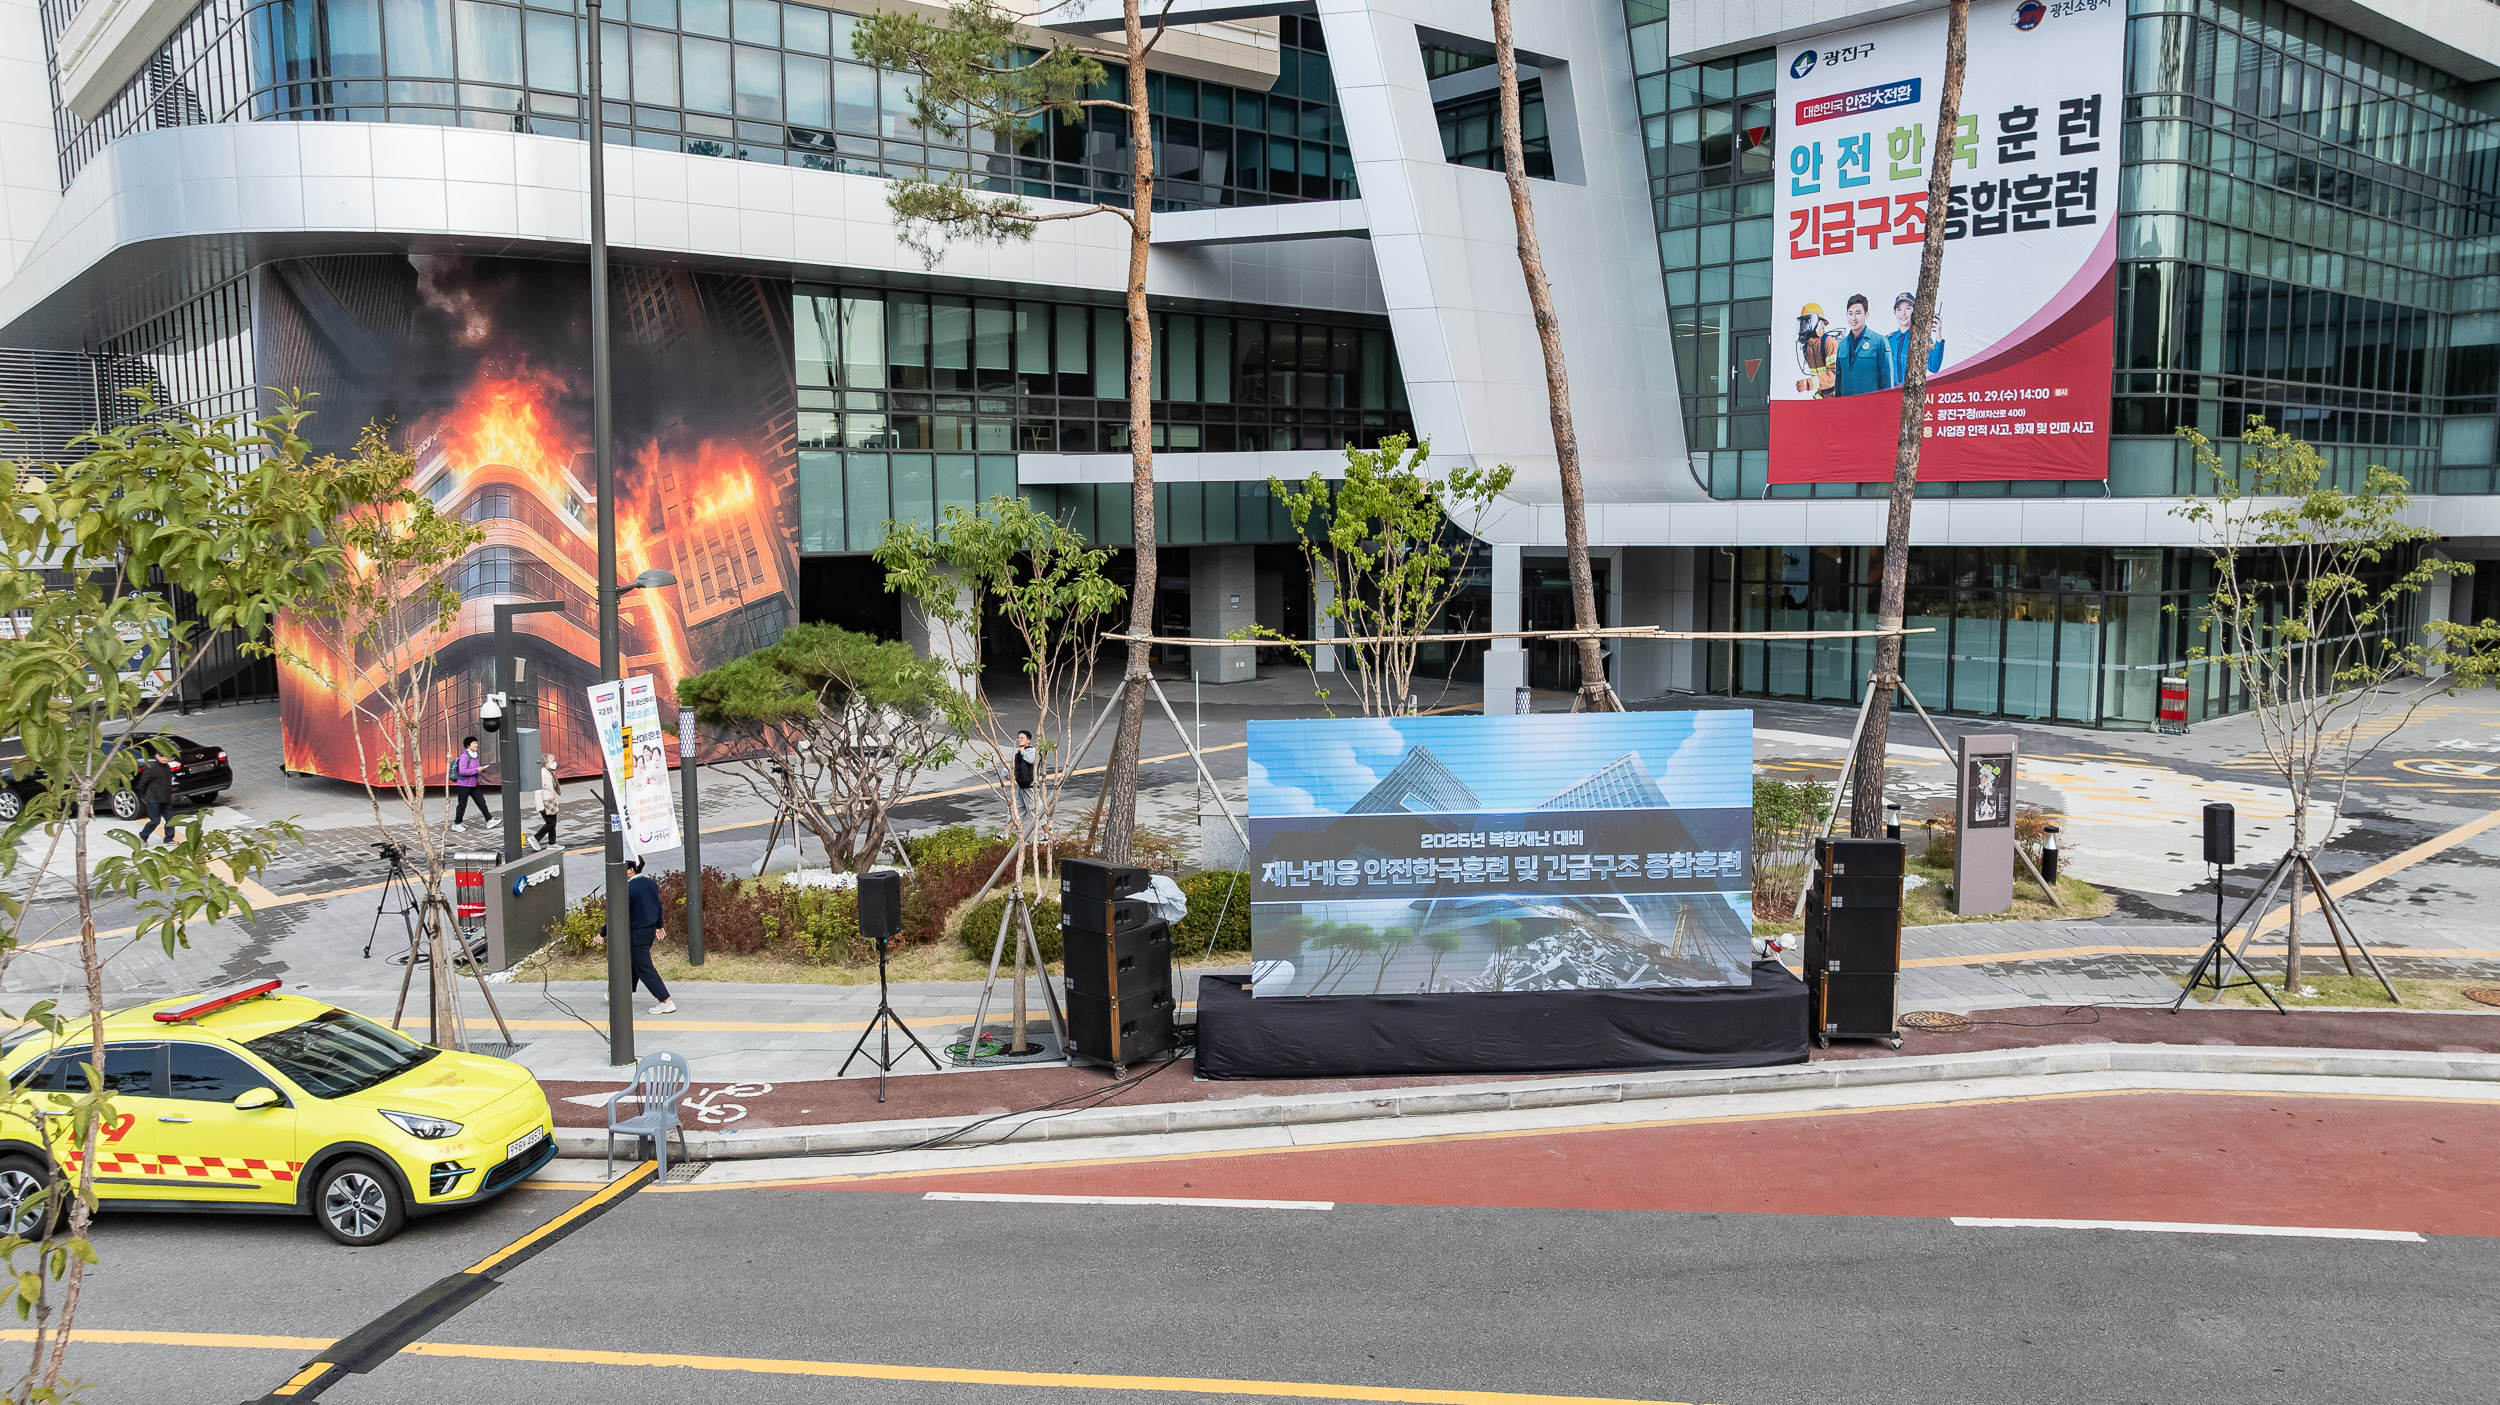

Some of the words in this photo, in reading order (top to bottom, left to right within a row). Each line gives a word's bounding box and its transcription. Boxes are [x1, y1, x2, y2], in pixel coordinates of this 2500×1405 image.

[1822, 43, 1875, 66] 광진구
[1803, 99, 1844, 119] 대한민국
[1845, 84, 1912, 112] 안전大전환
[1937, 392, 1966, 404] 2025.
[1968, 391, 1982, 403] 10.
[2019, 388, 2050, 400] 14:00
[1937, 425, 1966, 437] 사업장
[1967, 424, 1988, 436] 인적
[1989, 424, 2012, 436] 사고,
[2013, 423, 2034, 435] 화재
[2036, 422, 2048, 435] 및
[2049, 422, 2070, 434] 인파
[2072, 421, 2094, 434] 사고
[1420, 832, 1486, 849] 2025년
[1488, 830, 1551, 848] 복합재난
[1553, 829, 1584, 846] 대비
[1261, 858, 1361, 888] 재난대응
[1363, 855, 1510, 885] 안전한국훈련
[1514, 854, 1539, 882] 및
[1543, 853, 1642, 882] 긴급구조
[1645, 850, 1742, 880] 종합훈련
